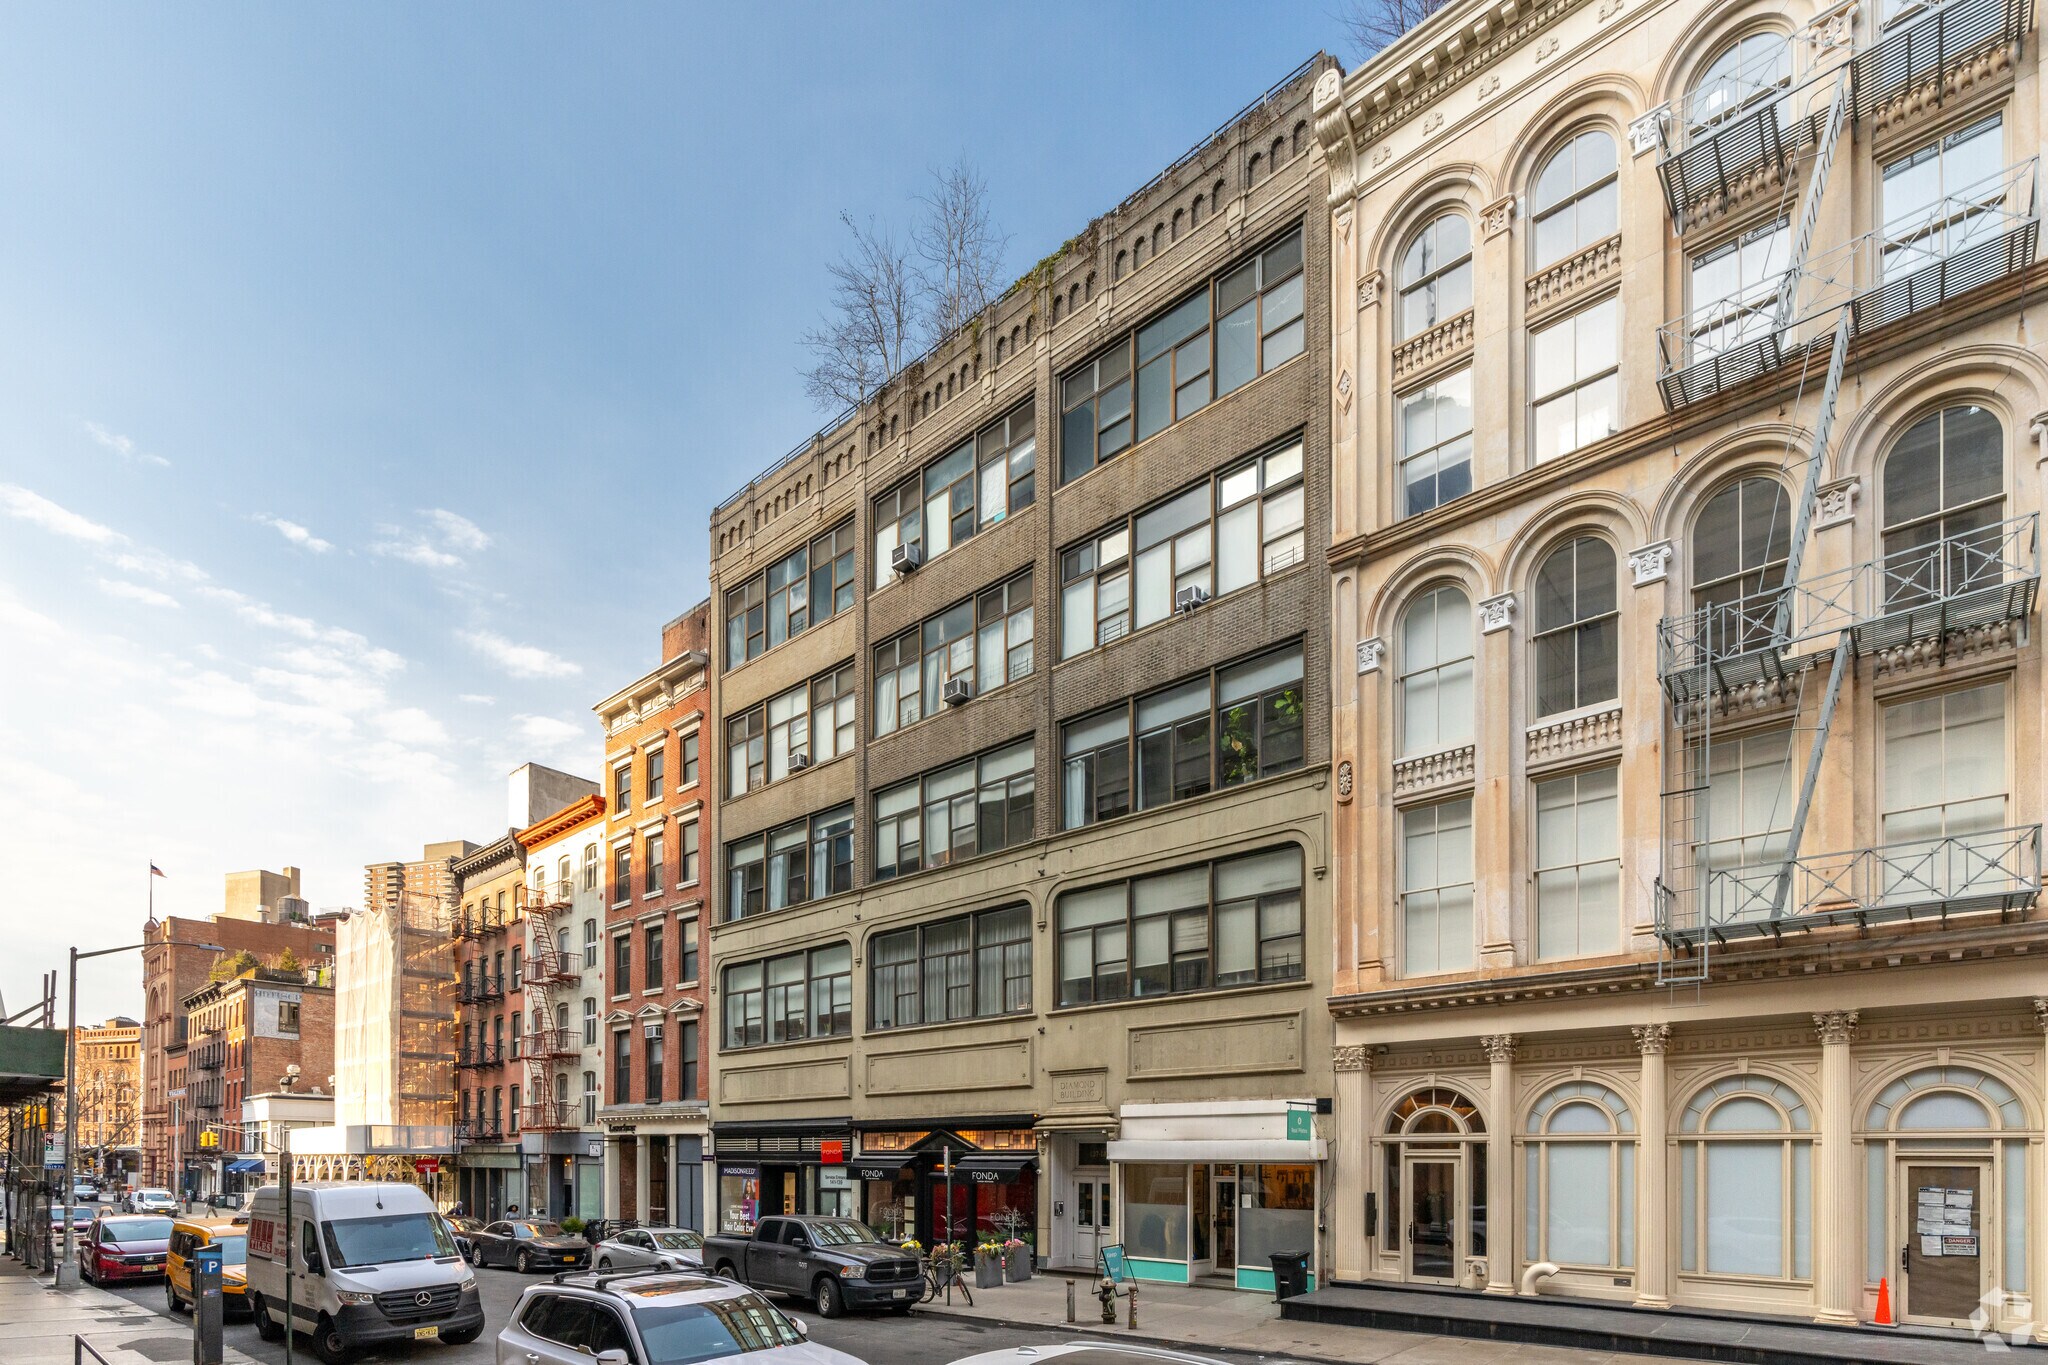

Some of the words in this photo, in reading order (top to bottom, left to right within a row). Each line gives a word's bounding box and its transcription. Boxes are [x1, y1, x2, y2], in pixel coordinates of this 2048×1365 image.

[1060, 1081, 1095, 1090] DIAMOND
[1060, 1089, 1095, 1098] BUILDING
[861, 1169, 884, 1178] FONDA
[971, 1171, 999, 1180] FONDA
[729, 1209, 739, 1220] Your
[740, 1210, 750, 1221] Best
[724, 1221, 733, 1231] Hair
[733, 1221, 745, 1232] Color
[250, 1239, 271, 1253] TILES
[208, 1261, 218, 1273] P
